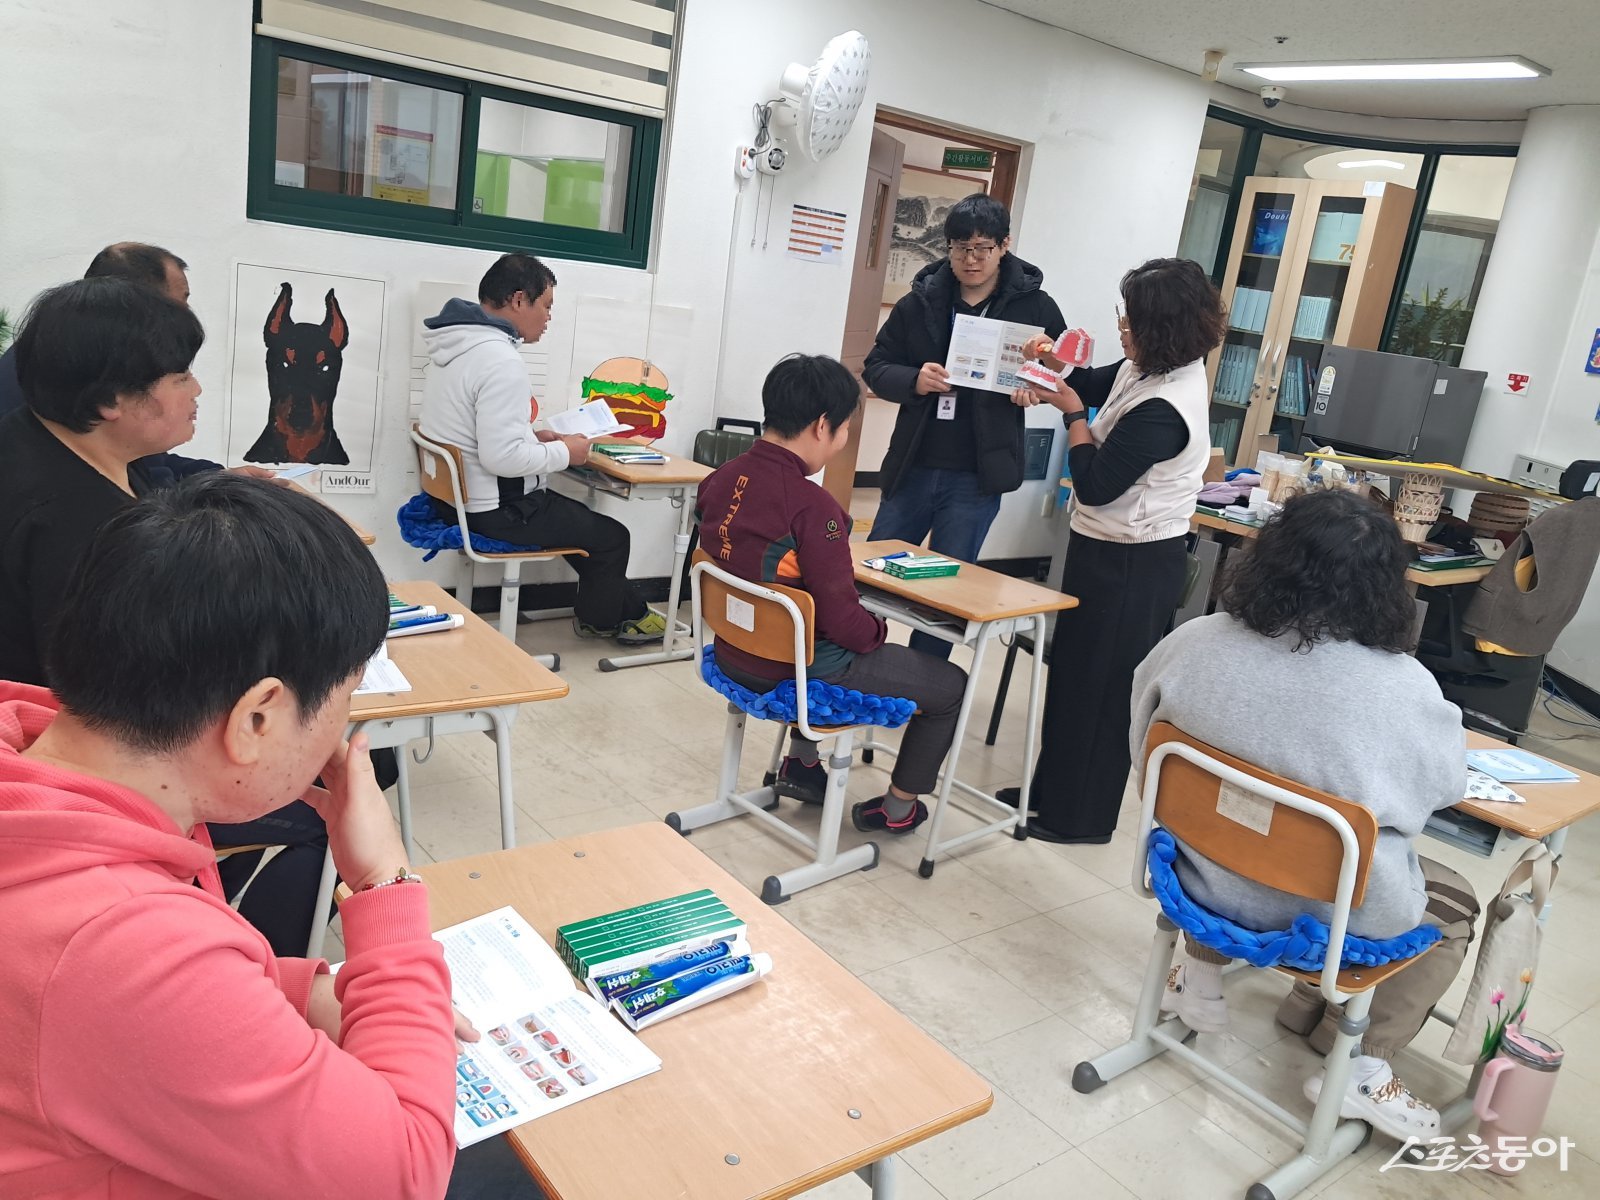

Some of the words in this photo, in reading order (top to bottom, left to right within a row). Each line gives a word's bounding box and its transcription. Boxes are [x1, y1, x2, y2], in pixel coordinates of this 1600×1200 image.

[1315, 402, 1326, 411] 10
[325, 475, 371, 486] AndOur
[718, 475, 749, 561] EXTREME
[606, 970, 641, 990] 후레쉬
[632, 986, 667, 1009] 후레쉬
